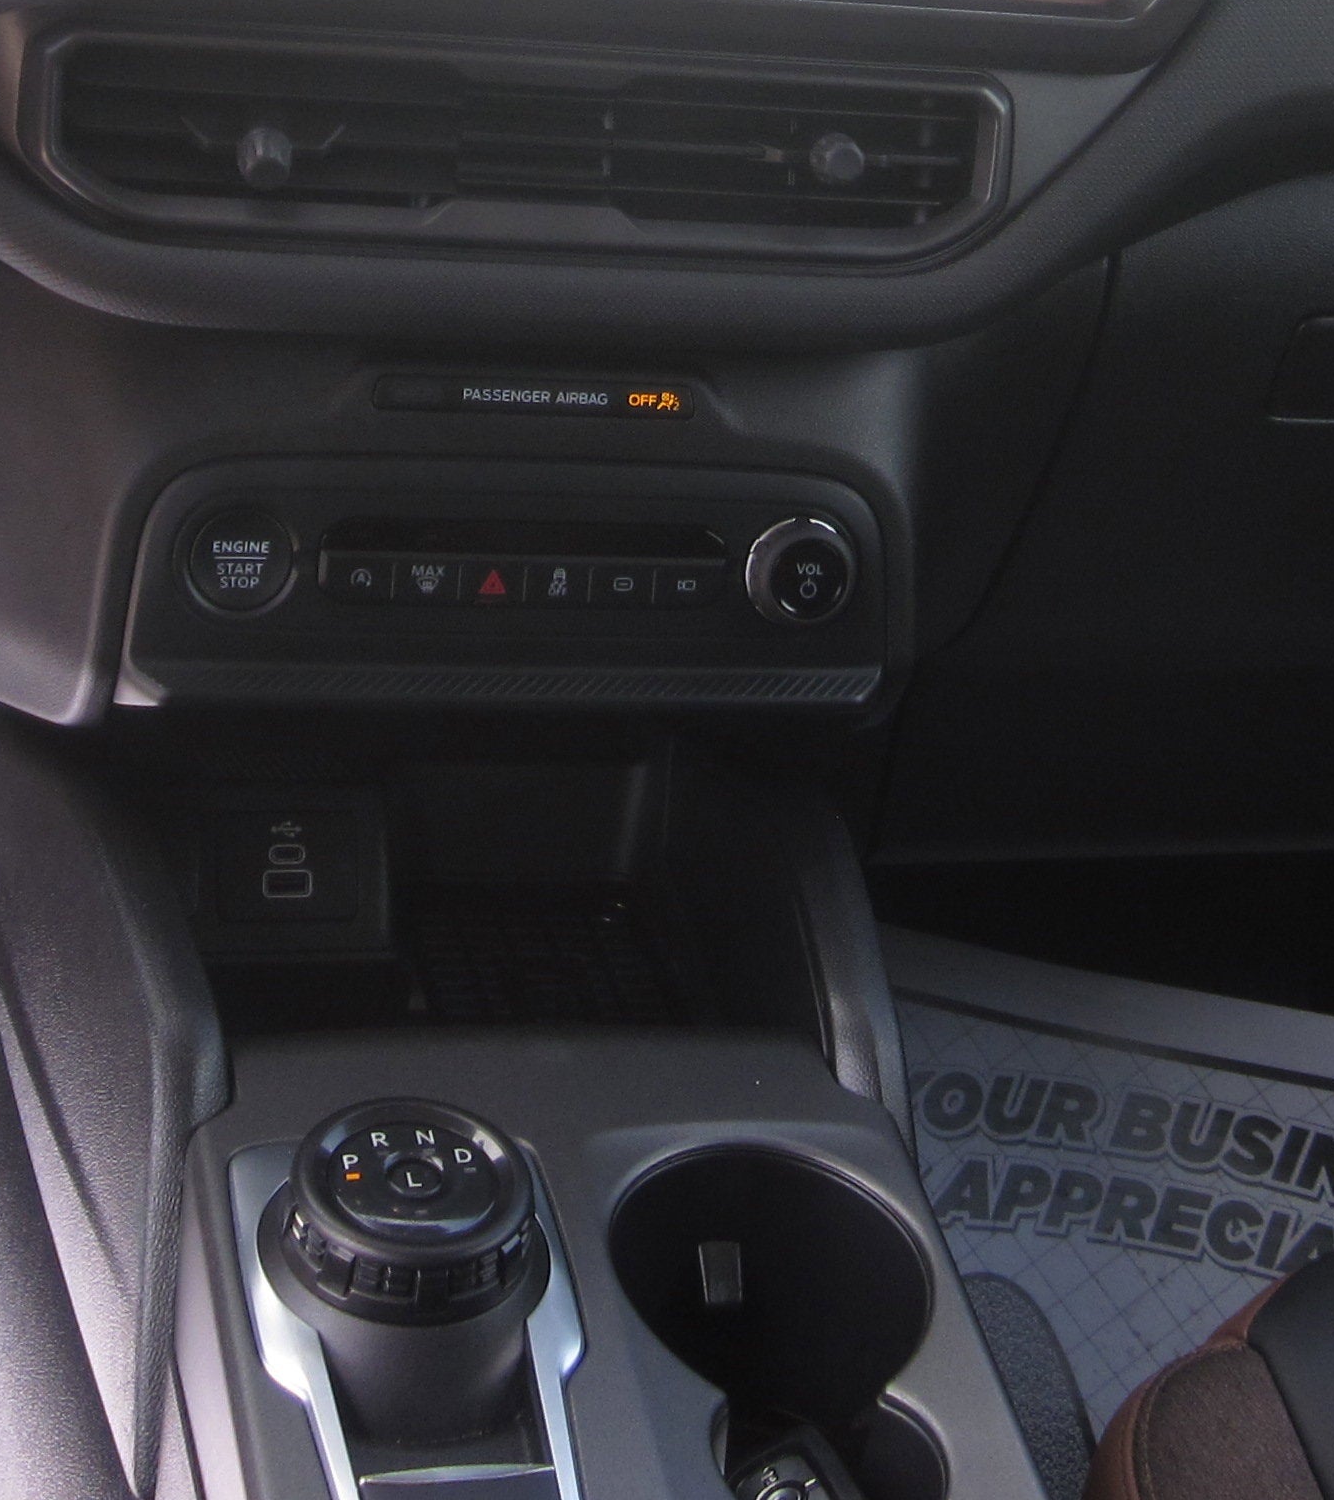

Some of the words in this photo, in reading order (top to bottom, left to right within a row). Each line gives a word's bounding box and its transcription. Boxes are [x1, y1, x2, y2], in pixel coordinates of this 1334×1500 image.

[463, 387, 551, 404] PASSENGER
[555, 392, 609, 407] AIRBAG
[628, 393, 657, 408] OFF
[212, 540, 271, 554] ENGINE
[216, 562, 264, 575] START
[411, 564, 446, 577] MAX
[796, 563, 824, 577] VOL
[219, 576, 260, 589] STOP
[370, 1132, 389, 1148] R
[415, 1129, 435, 1145] N
[342, 1153, 359, 1170] P
[453, 1148, 473, 1165] D
[405, 1171, 423, 1188] L
